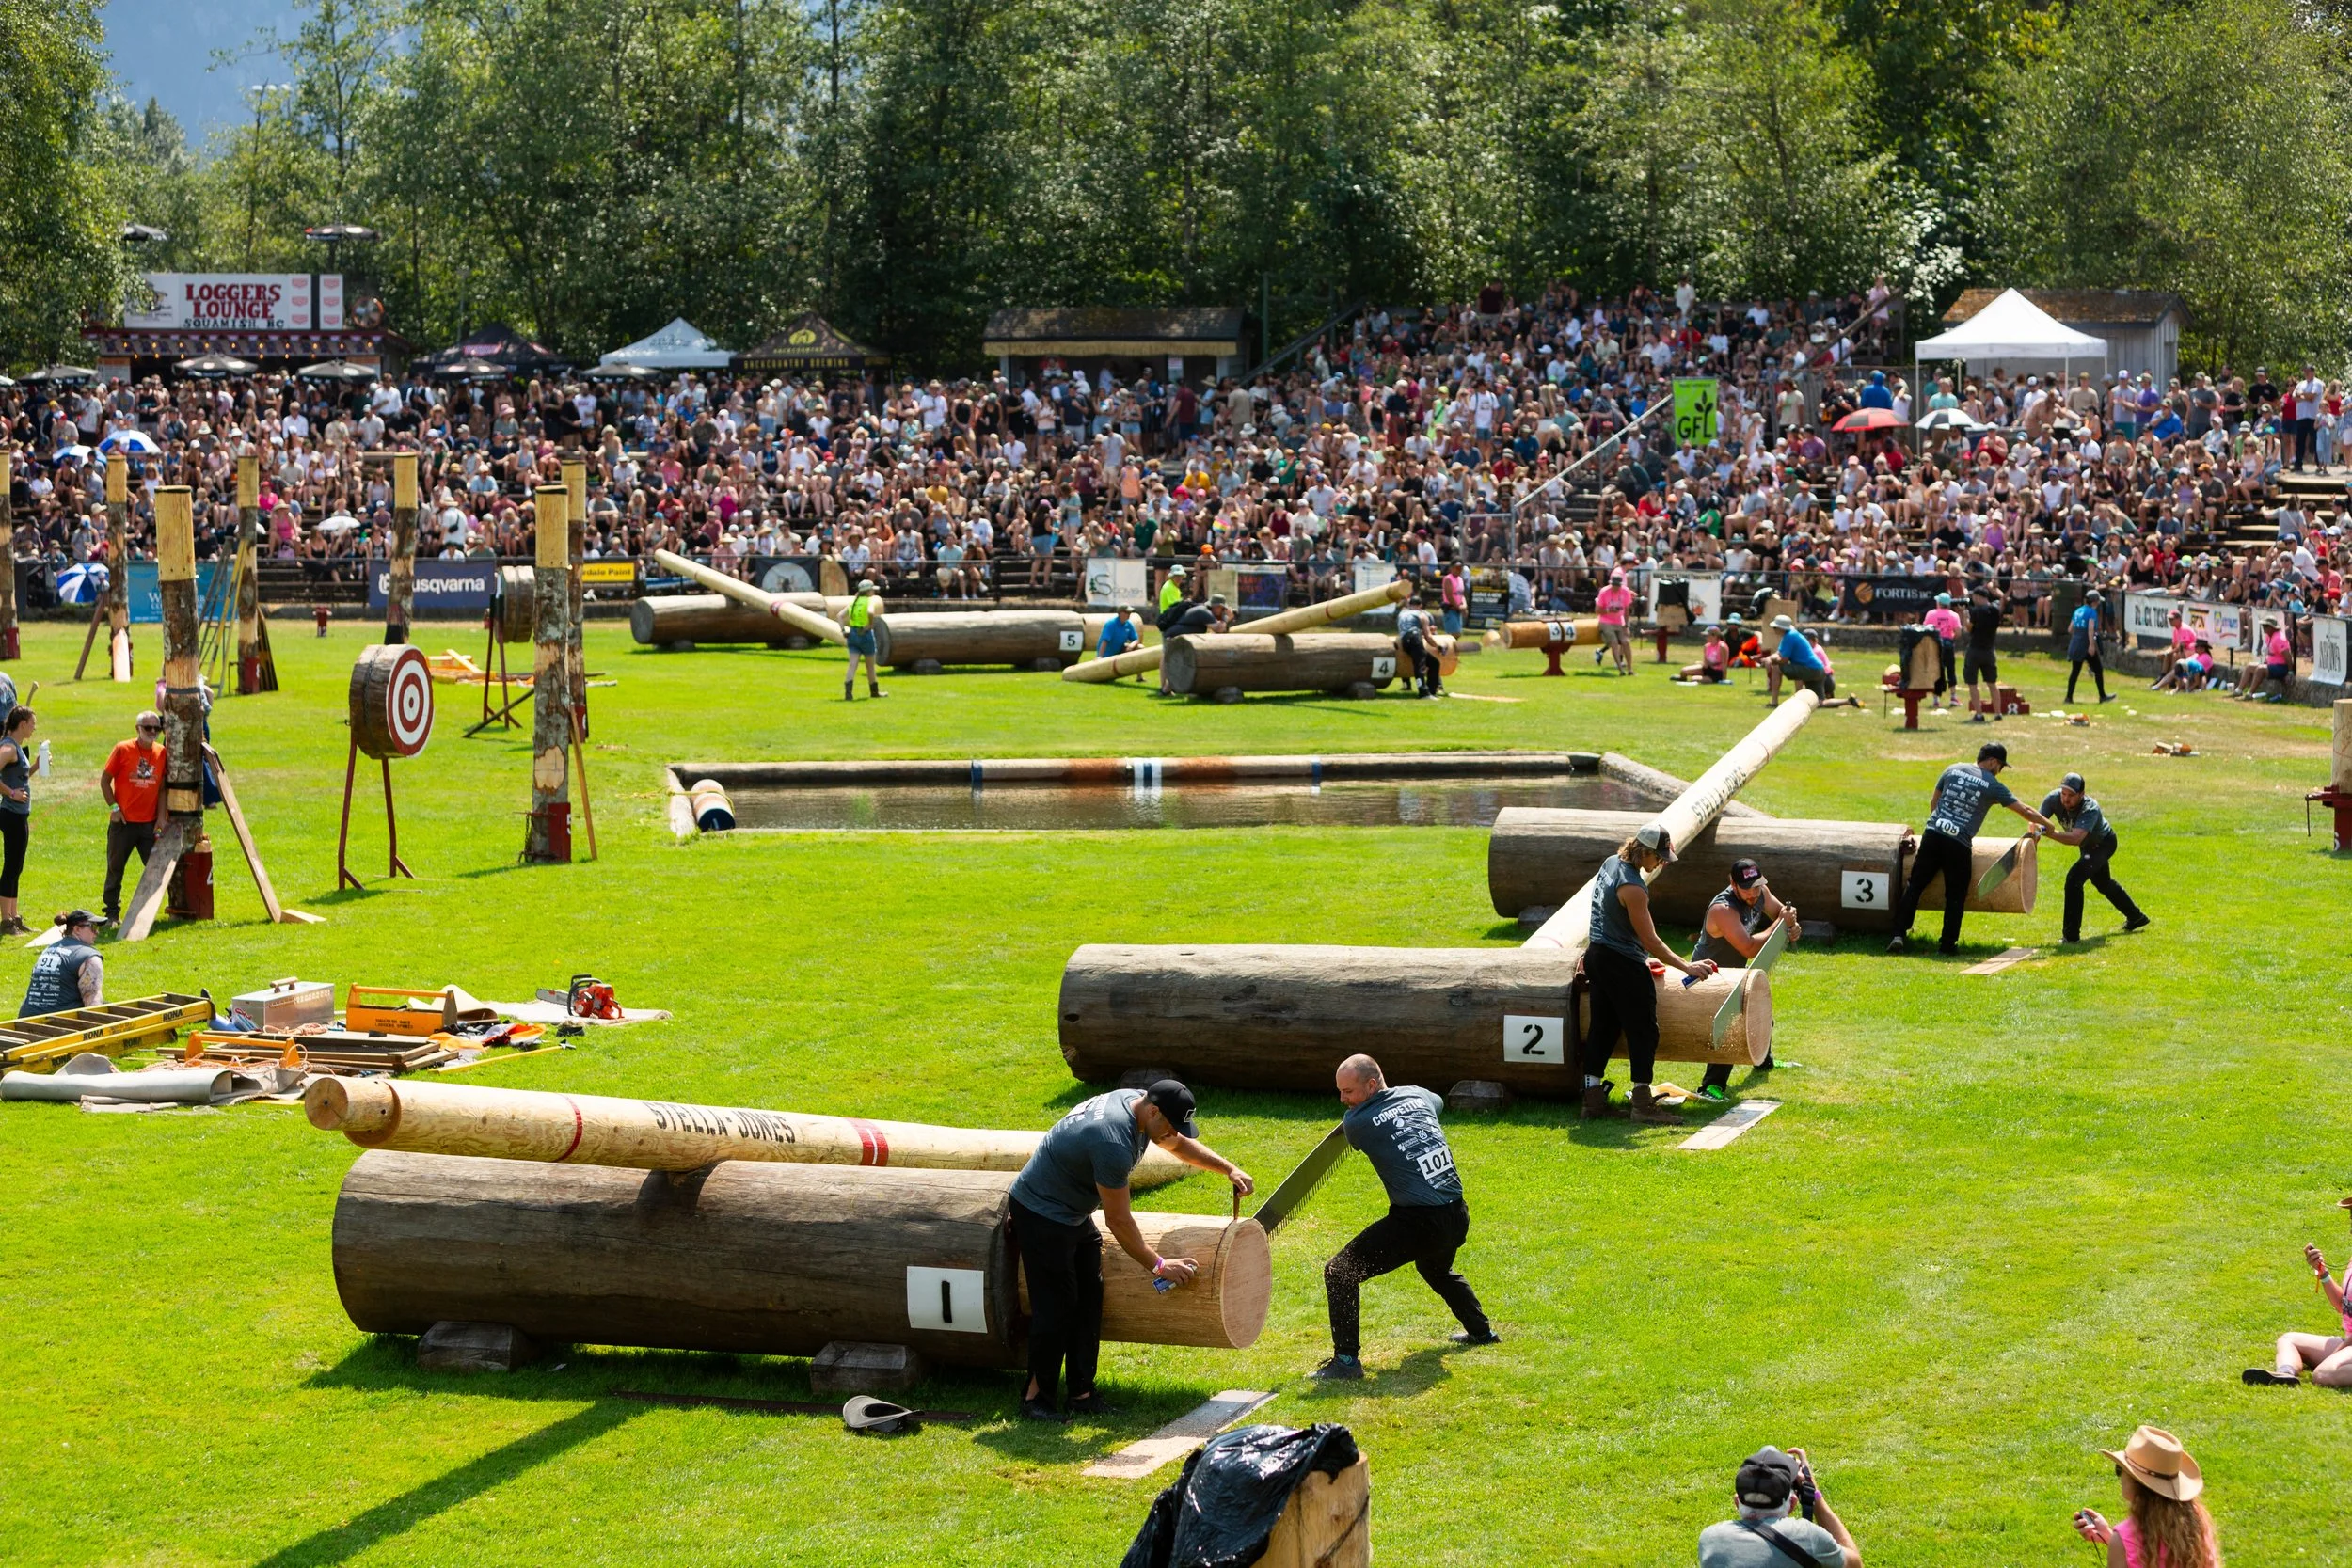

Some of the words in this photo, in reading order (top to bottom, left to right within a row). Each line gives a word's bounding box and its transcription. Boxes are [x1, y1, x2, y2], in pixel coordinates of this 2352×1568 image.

[185, 283, 282, 301] LOGGERS
[193, 300, 275, 318] LOUNGE
[267, 319, 284, 328] BC
[1677, 416, 1712, 439] GFL
[412, 577, 485, 594] usqvarna
[1067, 635, 1076, 647] 5
[1565, 626, 1575, 639] 4
[1378, 661, 1390, 675] 4
[1951, 769, 1990, 788] COMPETITOR
[1855, 878, 1874, 903] 3
[162, 1009, 183, 1022] RONA
[83, 1028, 104, 1041] RONA
[1522, 1023, 1546, 1055] 2
[1372, 1098, 1426, 1126] COMPETITOR
[1422, 1150, 1450, 1175] 101
[942, 1280, 953, 1323] 1
